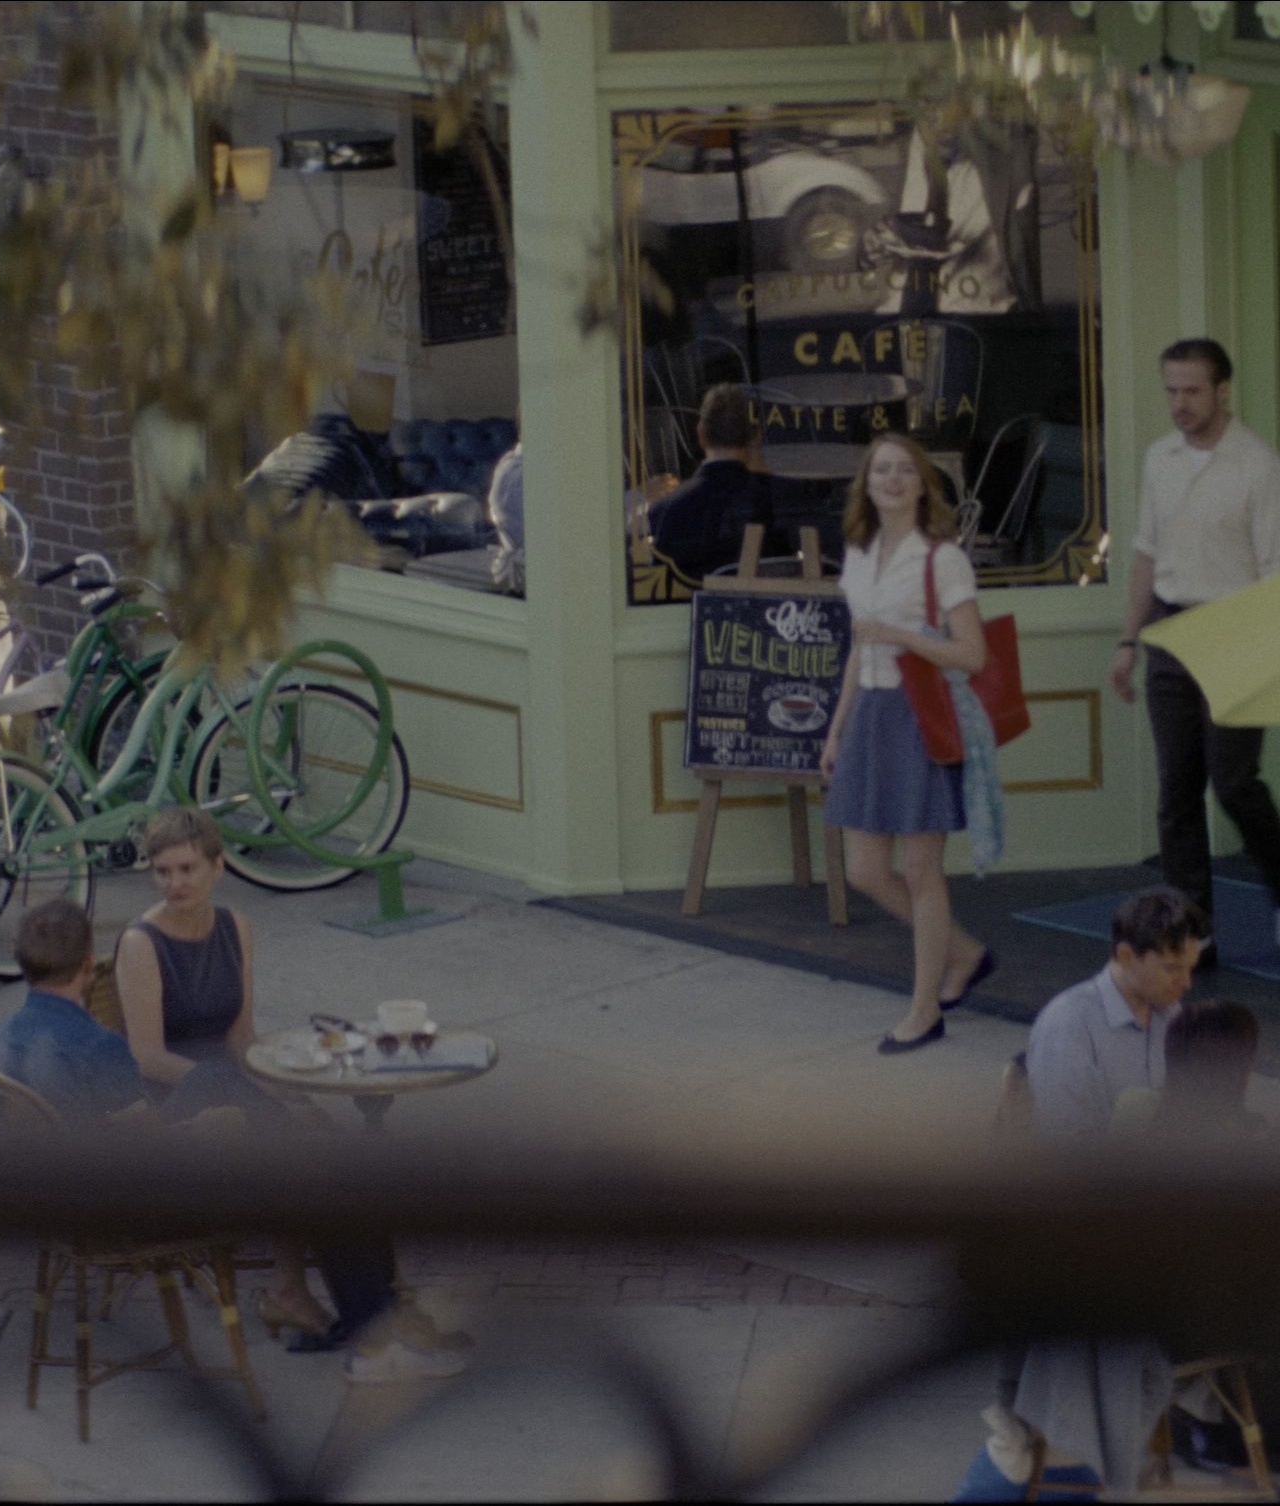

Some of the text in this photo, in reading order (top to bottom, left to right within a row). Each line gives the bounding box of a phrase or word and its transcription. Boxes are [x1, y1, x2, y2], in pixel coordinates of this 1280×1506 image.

[736, 268, 980, 308] CAPPUCCINO
[793, 320, 927, 365] CAFÉ
[749, 400, 846, 431] LATTE
[871, 405, 889, 430] &
[703, 619, 840, 678] WELCOME
